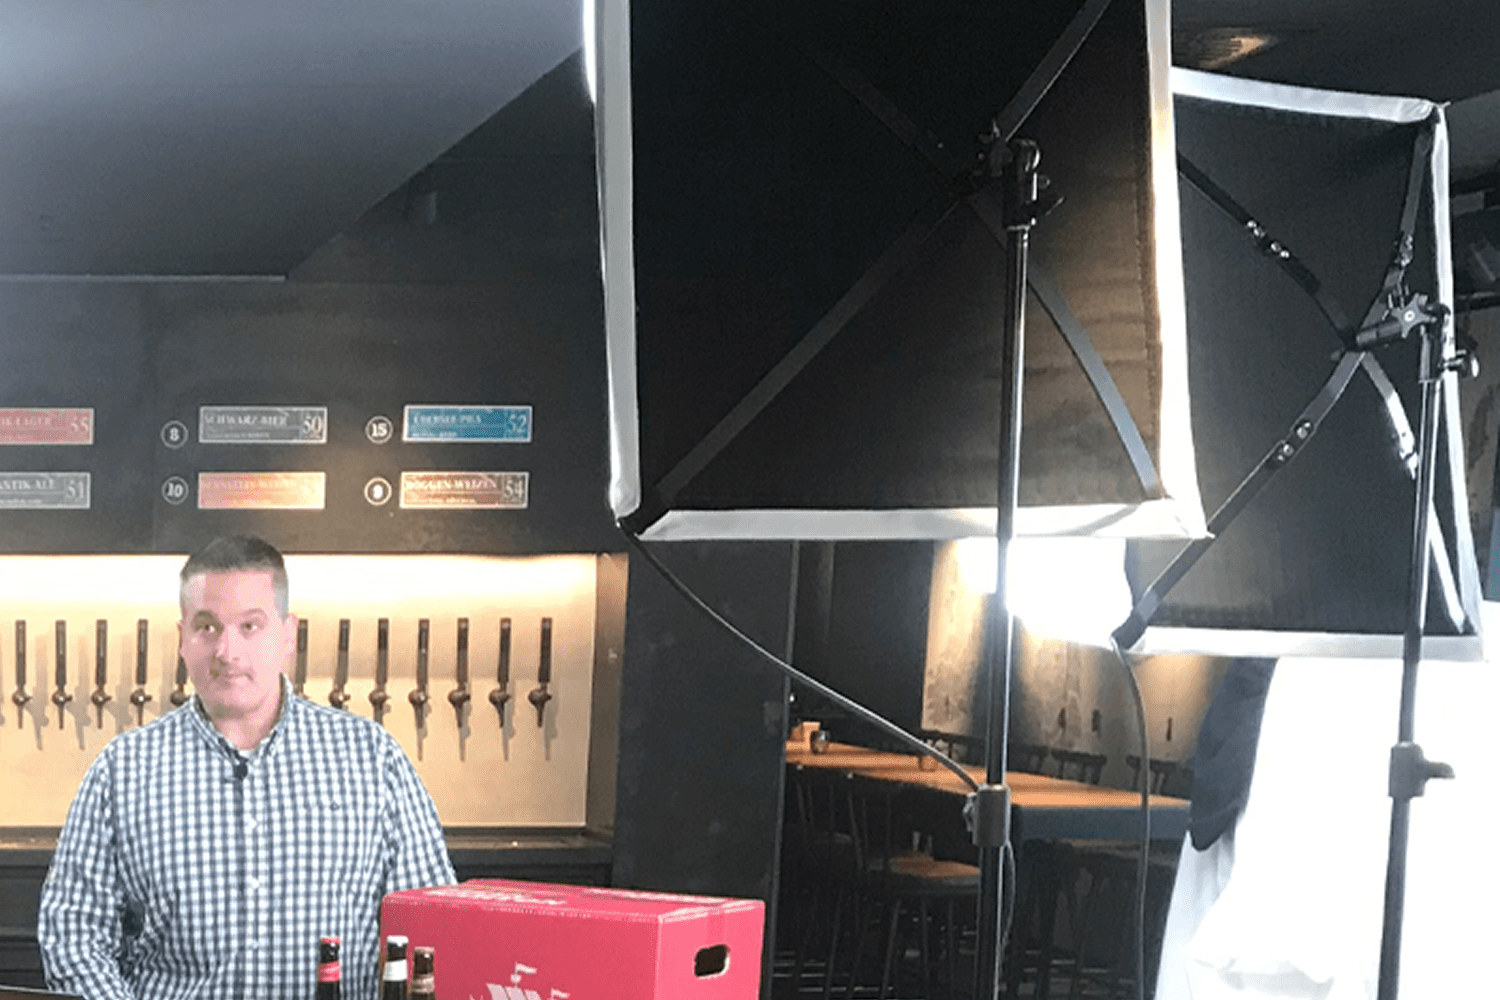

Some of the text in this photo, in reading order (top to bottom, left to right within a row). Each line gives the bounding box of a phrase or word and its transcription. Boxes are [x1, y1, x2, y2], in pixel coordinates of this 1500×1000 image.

[302, 414, 322, 434] 50
[371, 423, 388, 438] 15
[508, 414, 527, 433] 52
[169, 427, 180, 442] 8
[65, 480, 85, 499] 51
[167, 483, 183, 498] 10
[503, 480, 524, 499] 54
